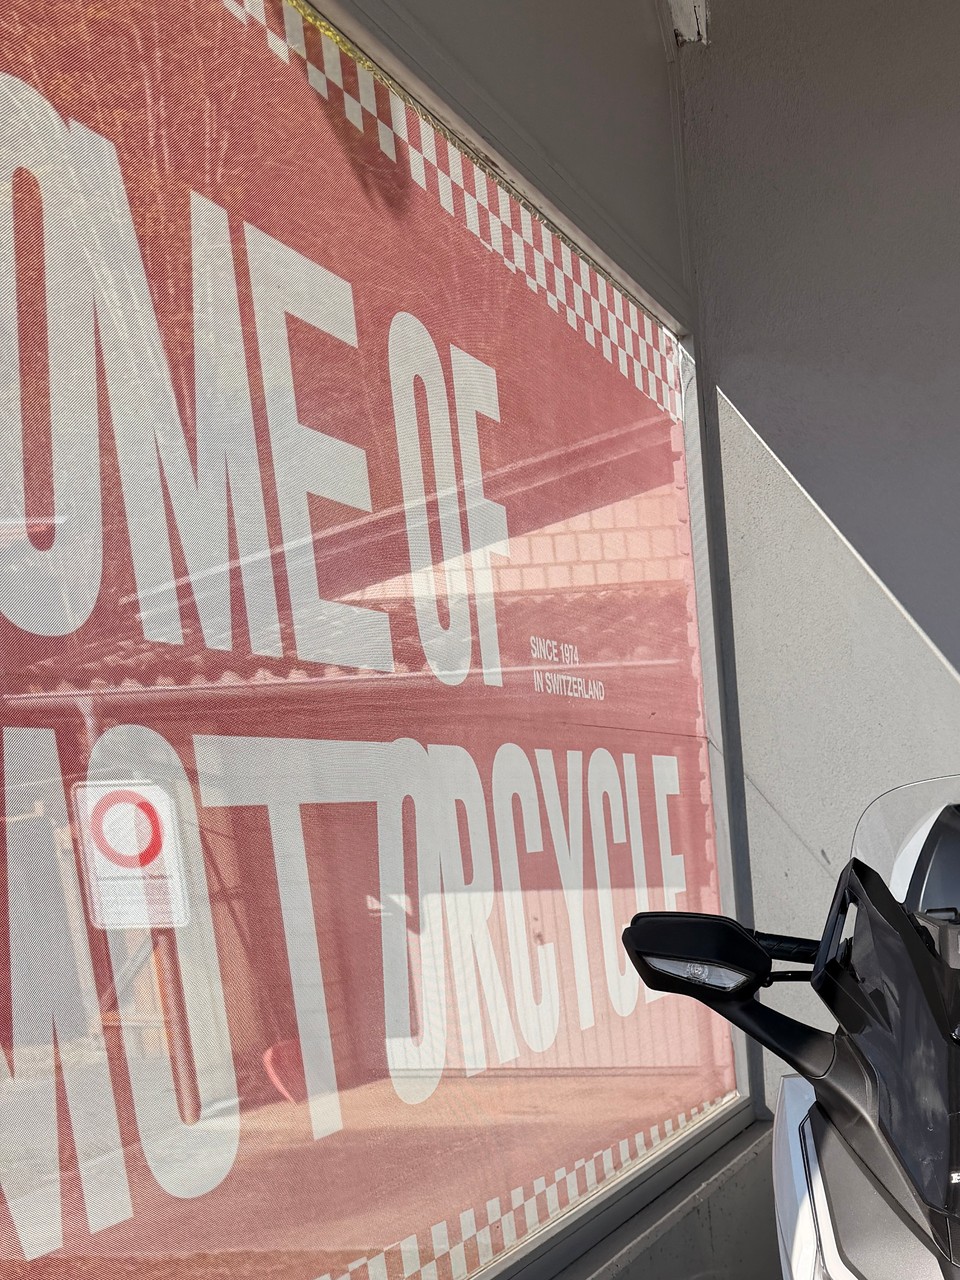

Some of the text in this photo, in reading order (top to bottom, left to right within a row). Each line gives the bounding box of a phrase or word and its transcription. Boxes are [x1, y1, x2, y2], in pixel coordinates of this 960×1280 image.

[388, 311, 511, 688] OF
[530, 635, 579, 666] SINCE 1974
[533, 669, 605, 701] IN SWITZERLAND
